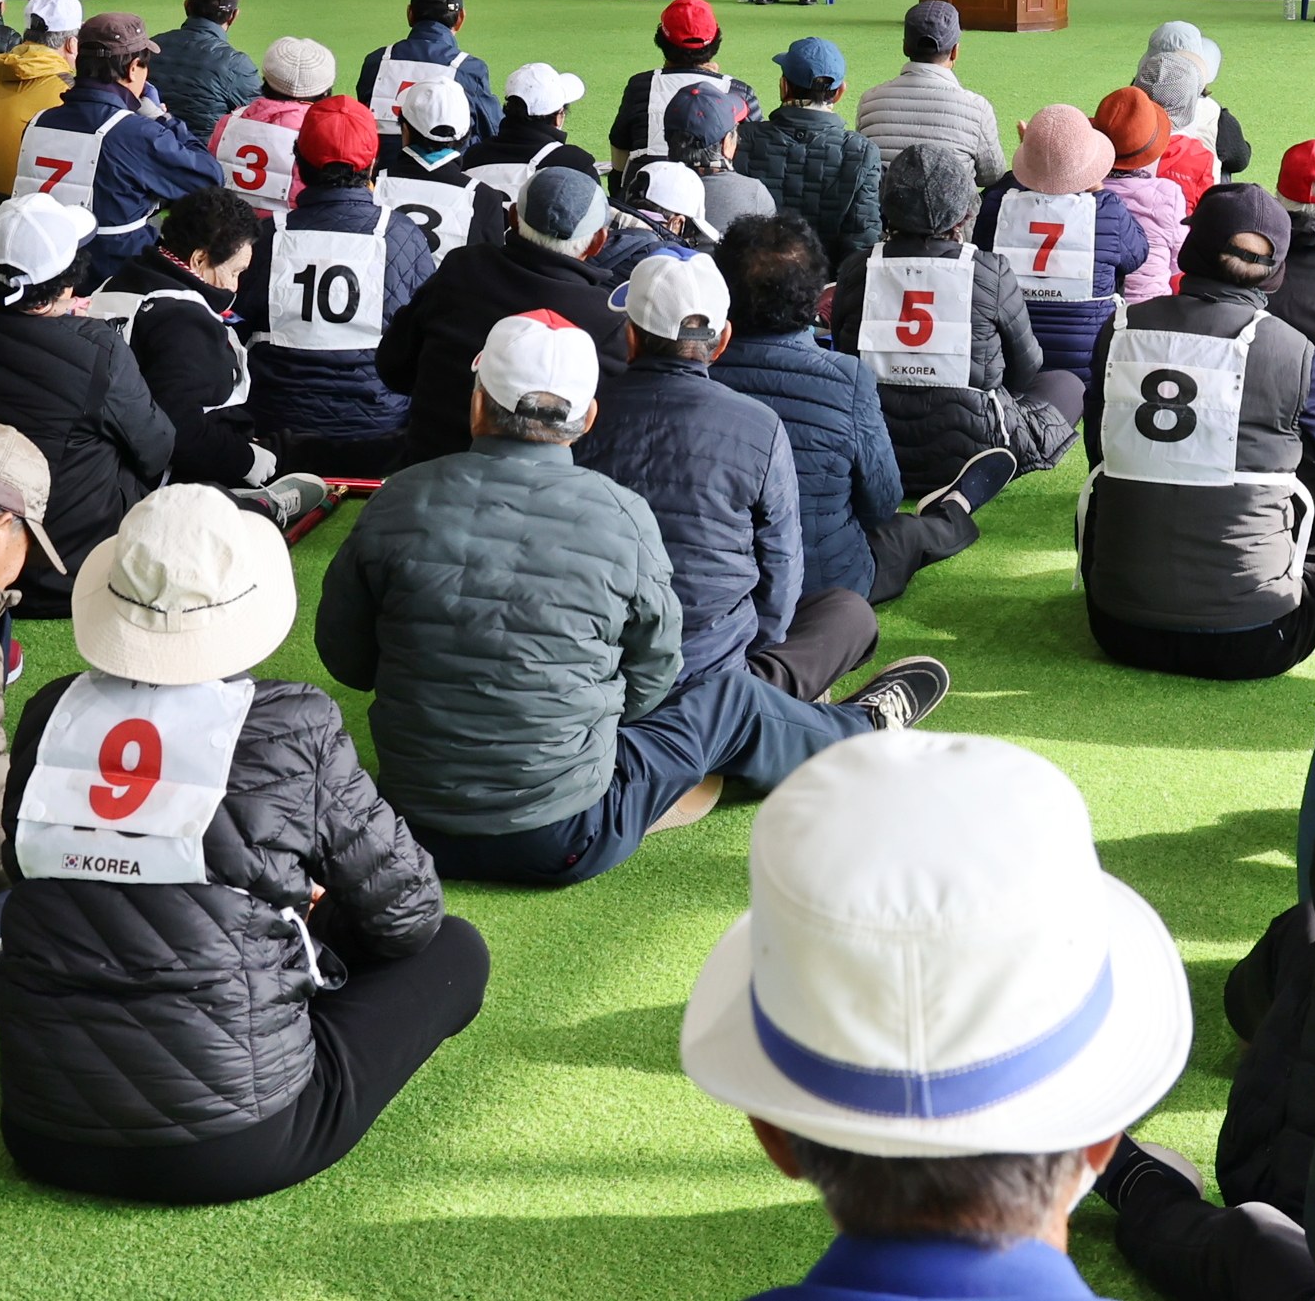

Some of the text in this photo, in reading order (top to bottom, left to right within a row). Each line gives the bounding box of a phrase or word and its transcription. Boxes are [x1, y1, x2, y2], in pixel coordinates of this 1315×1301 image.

[35, 156, 74, 194] 7
[232, 144, 269, 191] 3
[1028, 221, 1065, 272] 7
[293, 264, 361, 324] 10
[1031, 288, 1063, 298] KOREA
[895, 290, 935, 347] 5
[900, 365, 937, 376] KOREA
[1134, 368, 1198, 443] 8
[88, 718, 163, 821] 9
[81, 855, 142, 876] KOREA
